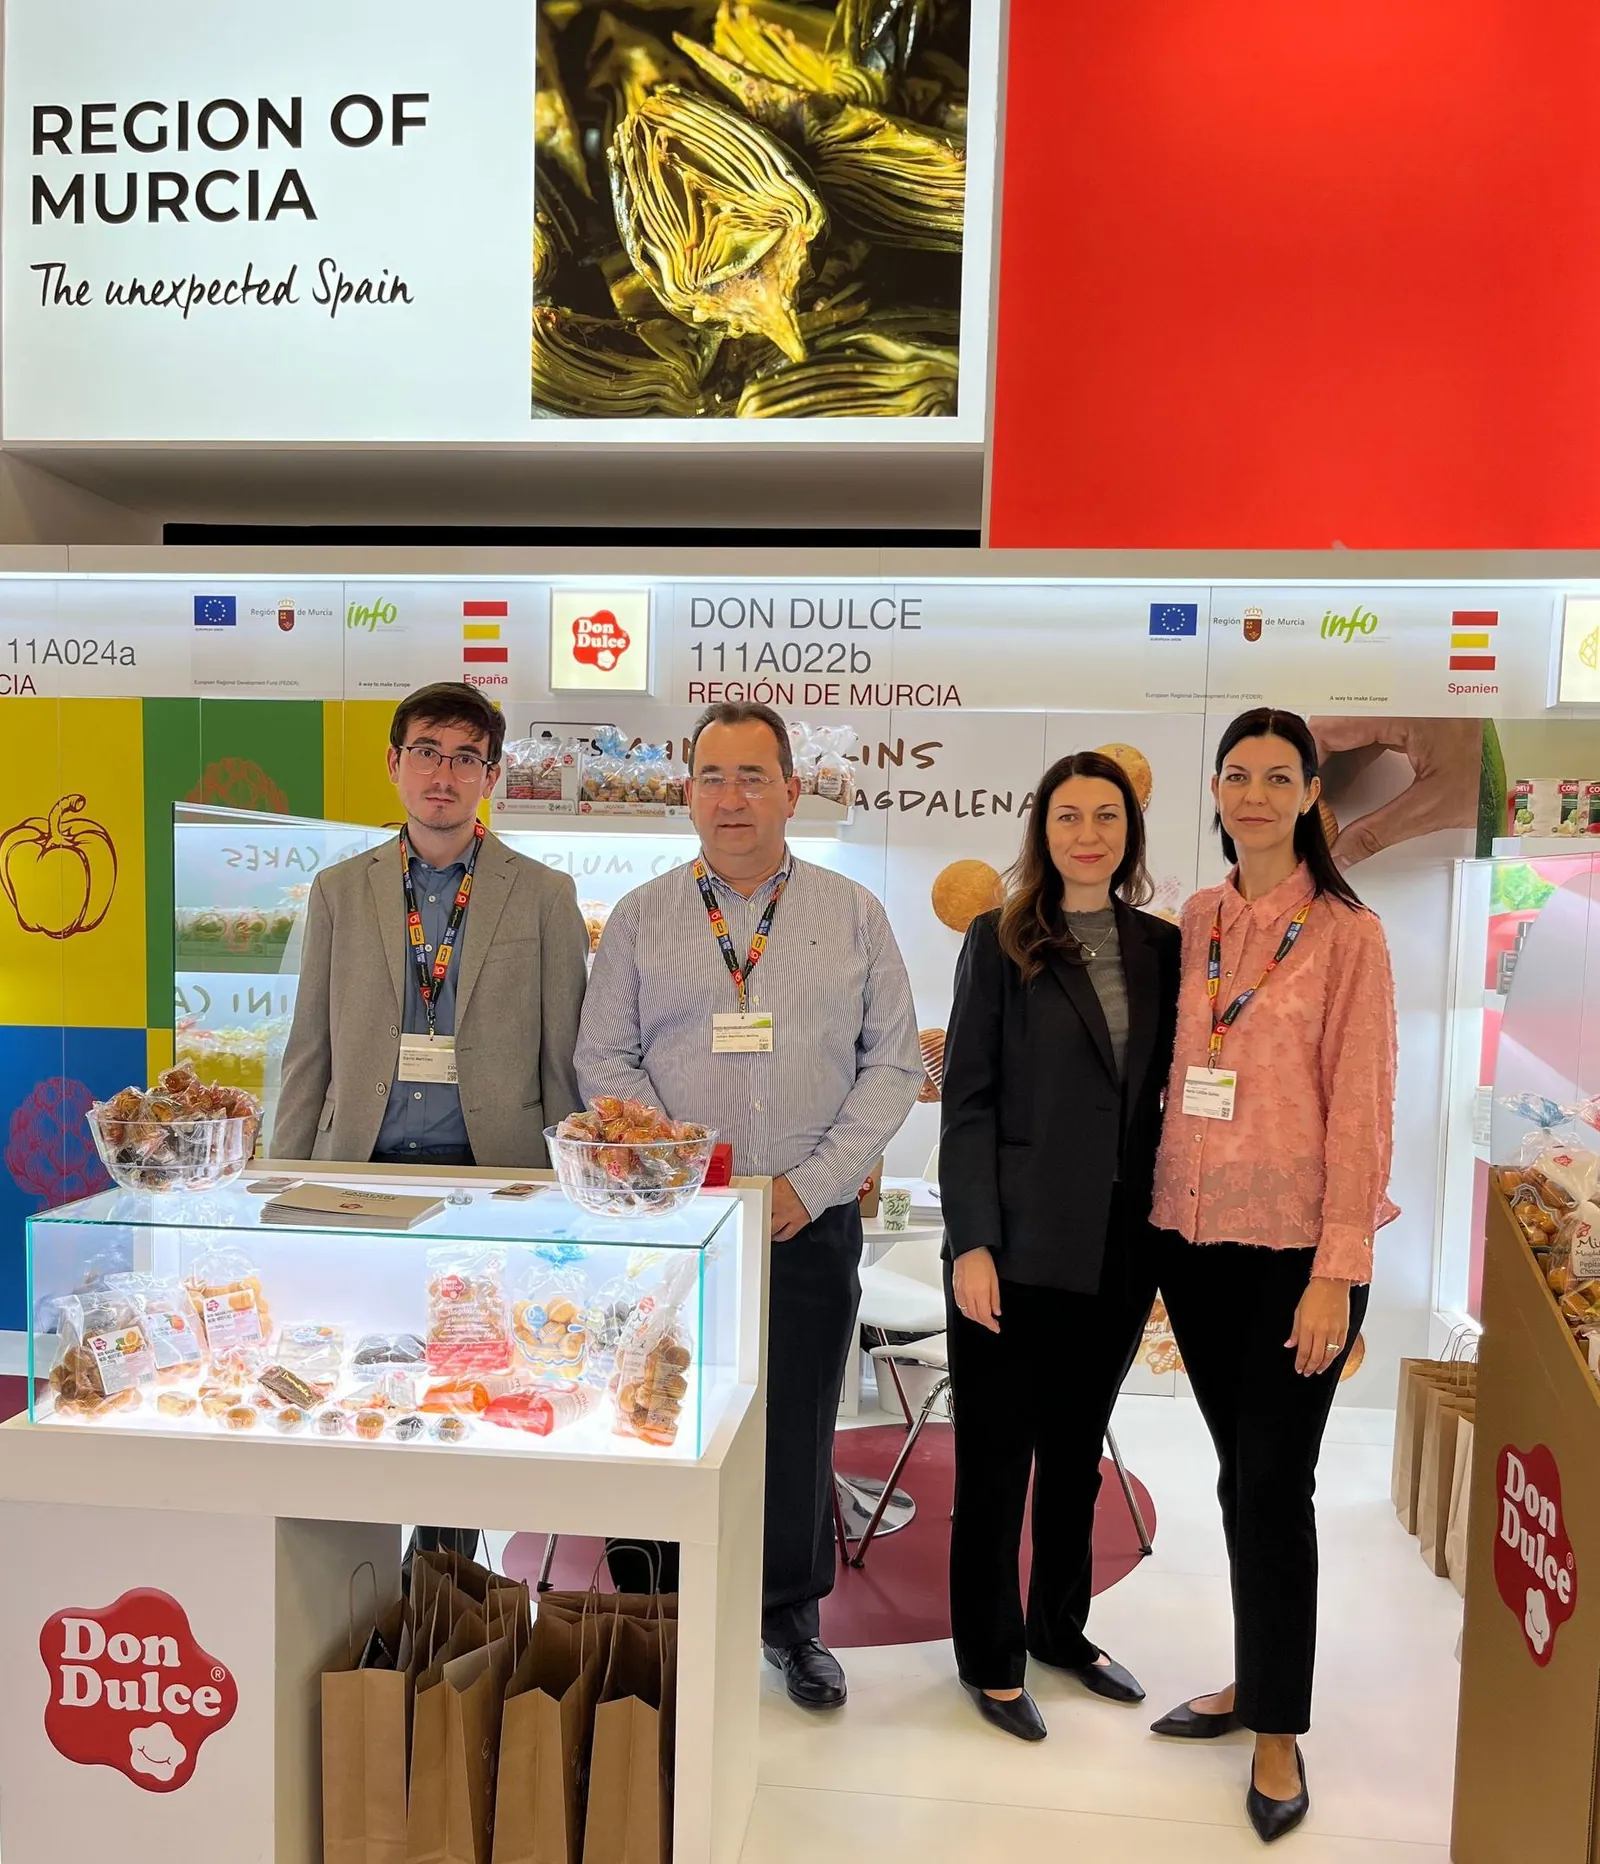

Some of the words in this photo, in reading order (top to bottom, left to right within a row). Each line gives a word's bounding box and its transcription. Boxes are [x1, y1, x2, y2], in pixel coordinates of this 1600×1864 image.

[32, 96, 302, 156] REGION
[330, 92, 430, 149] OF
[32, 168, 319, 226] MURCIA
[30, 261, 94, 308] The
[105, 262, 301, 320] unexpected
[311, 257, 415, 319] Spain
[250, 608, 276, 618] Región
[308, 609, 333, 617] Murcia
[346, 596, 398, 633] info
[578, 619, 615, 634] Don
[689, 597, 774, 630] DON
[790, 598, 923, 630] DULCE
[1213, 617, 1241, 627] Región
[1265, 617, 1276, 626] de
[1278, 618, 1306, 627] Murcia
[1320, 605, 1379, 644] info
[577, 633, 627, 649] Dulce
[690, 642, 872, 674] 111A022b
[463, 673, 509, 687] España
[687, 676, 794, 705] REGIÓN
[804, 684, 841, 706] DE
[849, 684, 962, 707] MURCIA
[1447, 682, 1499, 696] Spanien
[854, 788, 1037, 819] AGDALENA
[1504, 1451, 1557, 1538] Don
[1500, 1497, 1572, 1605] Dulce
[60, 1617, 182, 1668] Don
[58, 1664, 223, 1717] Dulce
